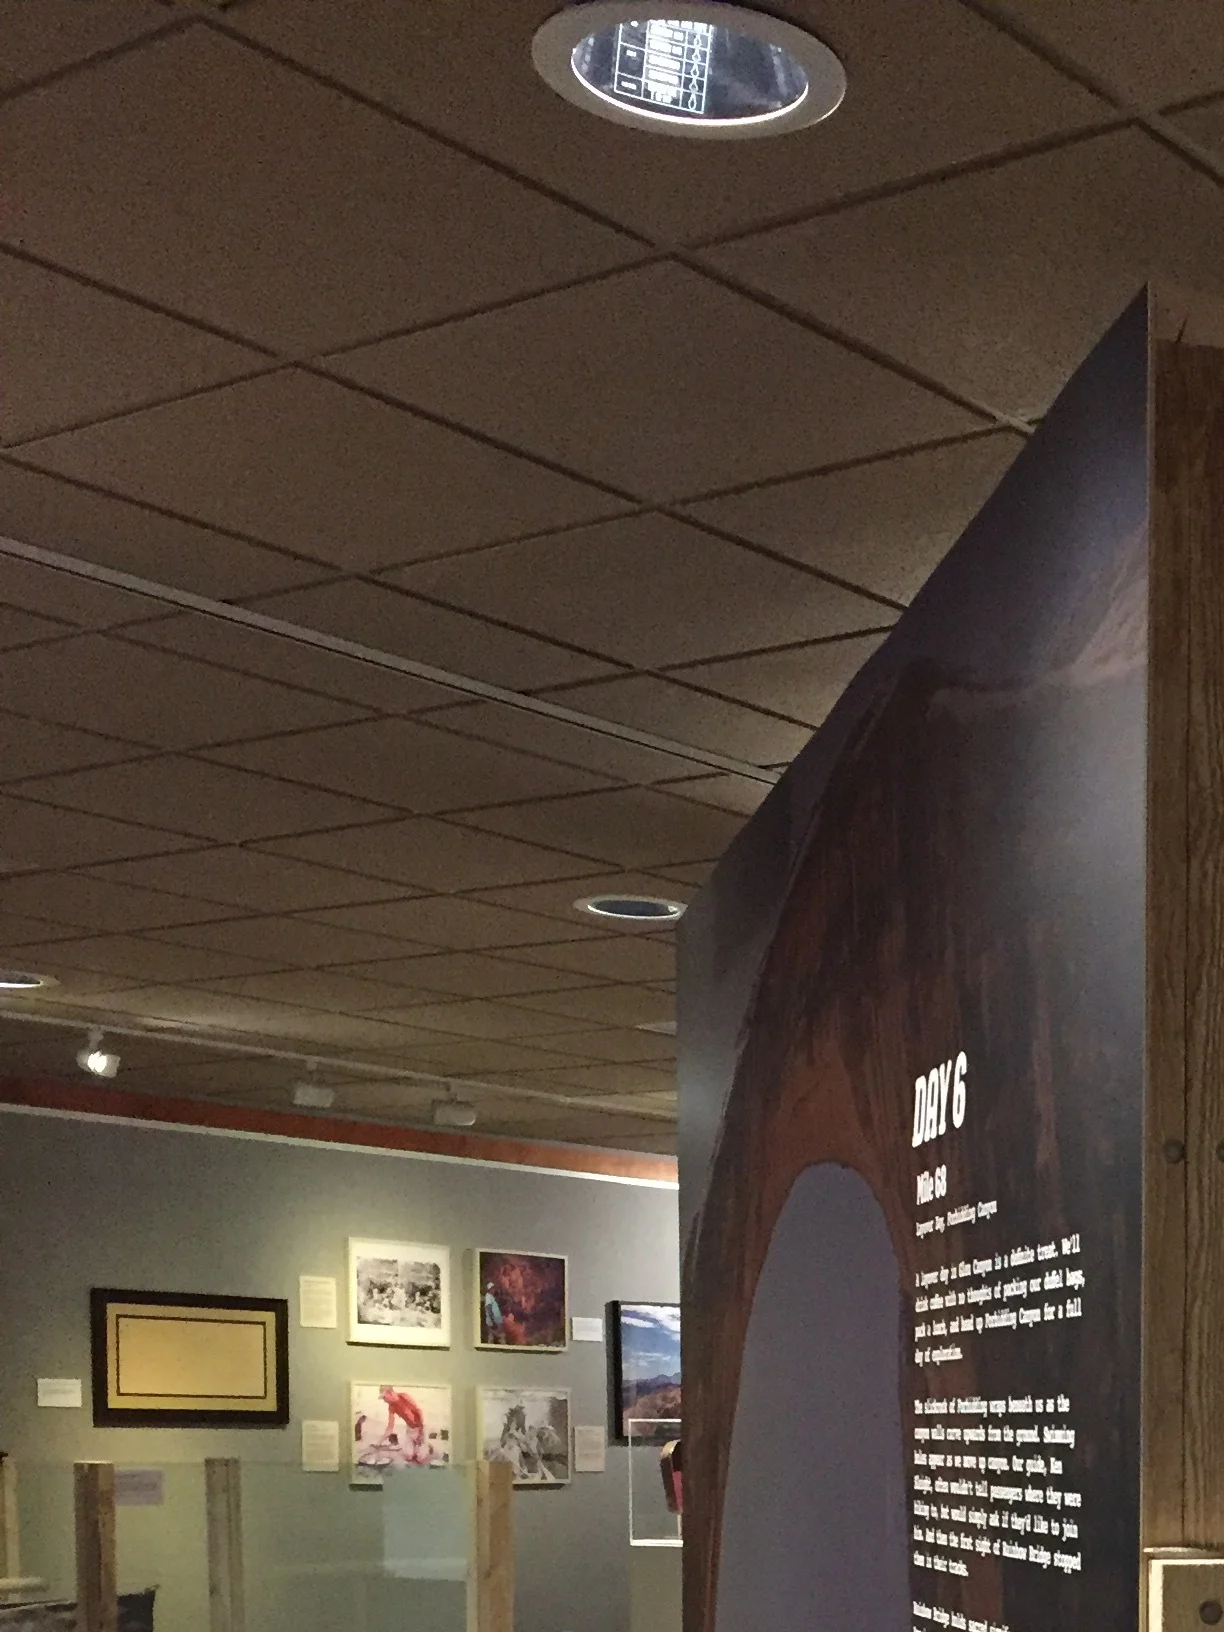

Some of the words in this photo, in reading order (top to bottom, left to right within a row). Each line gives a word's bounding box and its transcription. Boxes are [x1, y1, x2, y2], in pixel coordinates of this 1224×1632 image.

[912, 1059, 952, 1148] DAY
[953, 1051, 968, 1129] 6
[916, 1171, 934, 1205] Mile
[935, 1164, 947, 1198] 68
[1062, 1234, 1081, 1255] We'll
[1066, 1298, 1082, 1318] full
